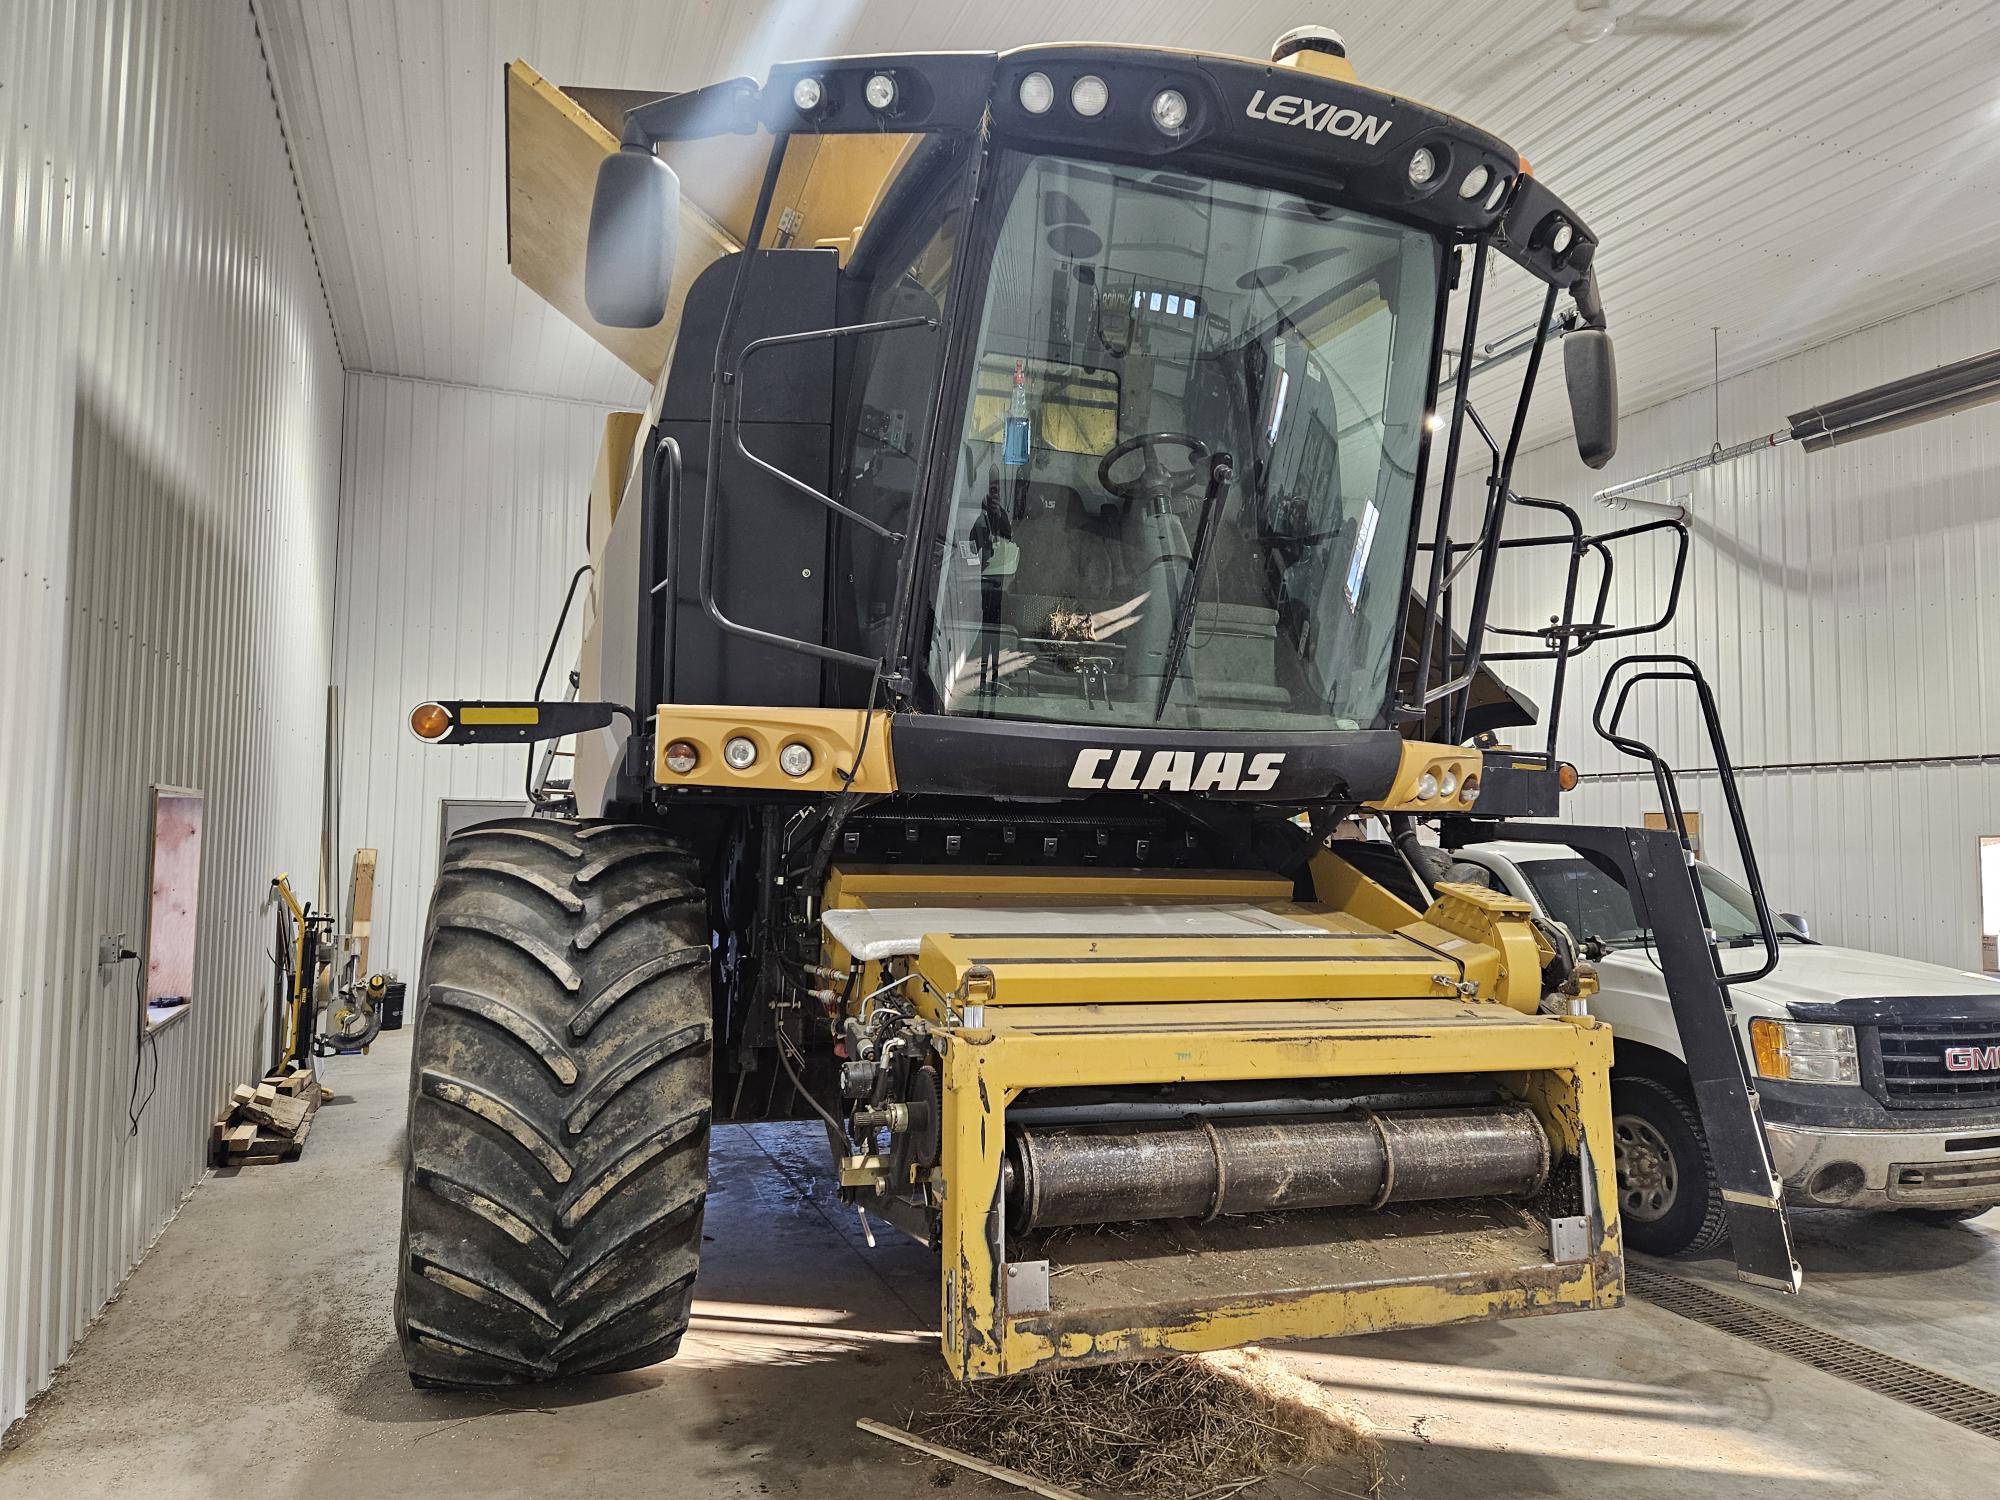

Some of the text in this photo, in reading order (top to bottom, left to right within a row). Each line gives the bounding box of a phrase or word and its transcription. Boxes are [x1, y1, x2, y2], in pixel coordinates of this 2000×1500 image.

[1246, 90, 1393, 146] LEXION
[1067, 748, 1287, 792] CLAAS
[1945, 1046, 2000, 1071] GM
